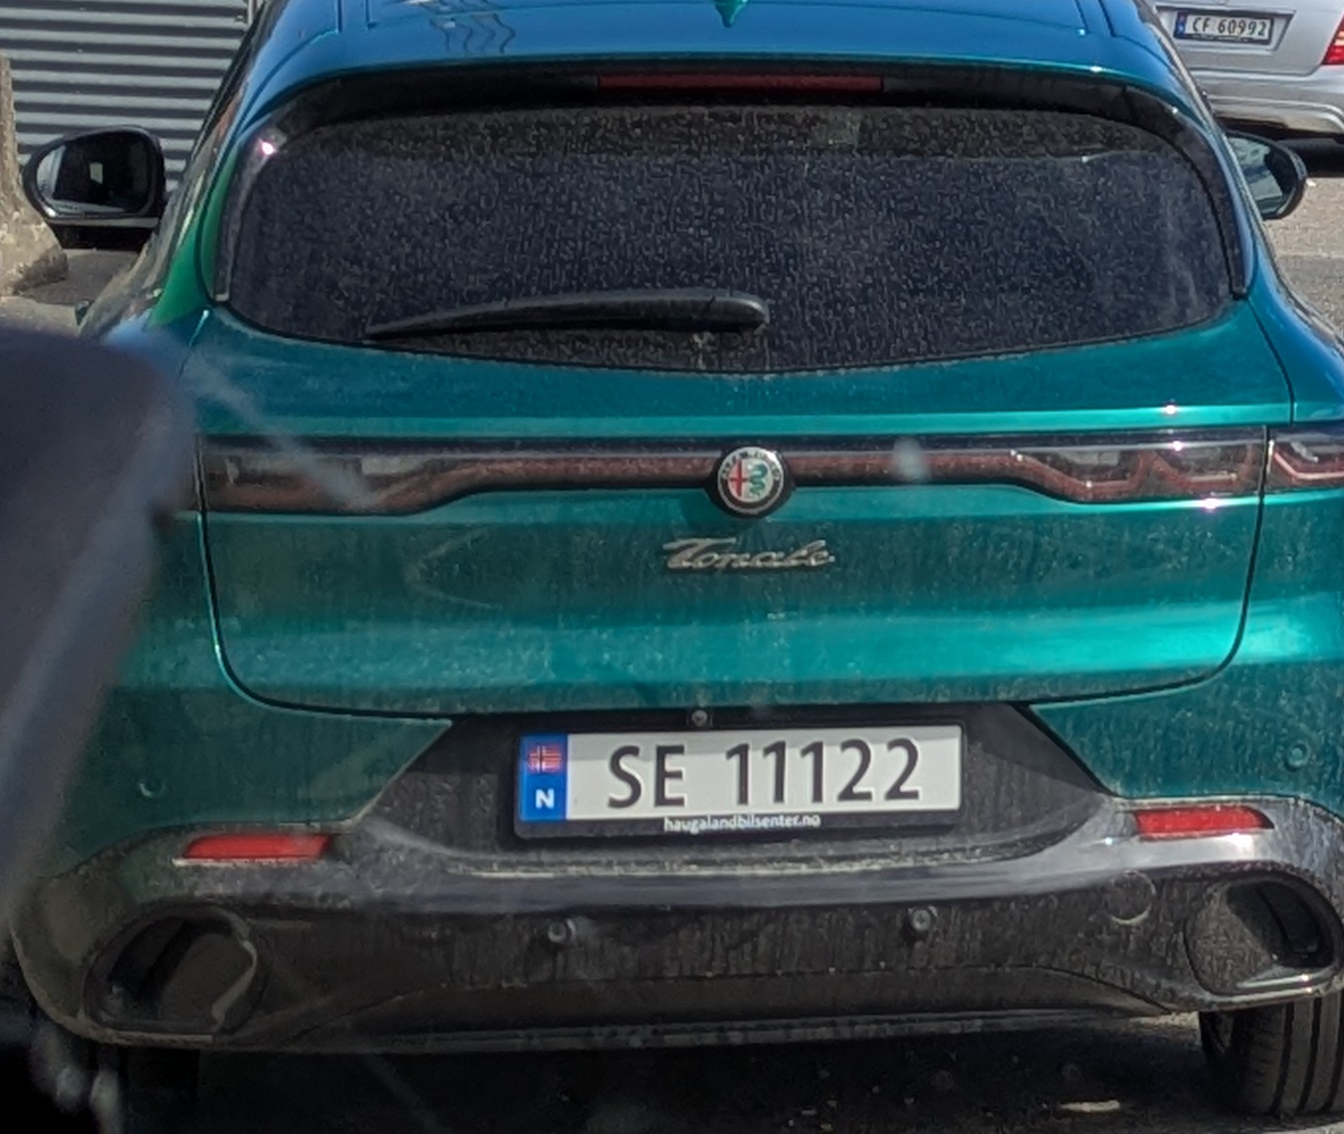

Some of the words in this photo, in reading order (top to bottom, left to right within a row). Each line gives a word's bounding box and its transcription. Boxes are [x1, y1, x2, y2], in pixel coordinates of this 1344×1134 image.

[662, 538, 836, 568] Tonale
[608, 745, 685, 808] SE
[725, 739, 920, 805] 11122
[535, 788, 554, 809] N
[663, 814, 821, 835] haugalandbilsenter.no
